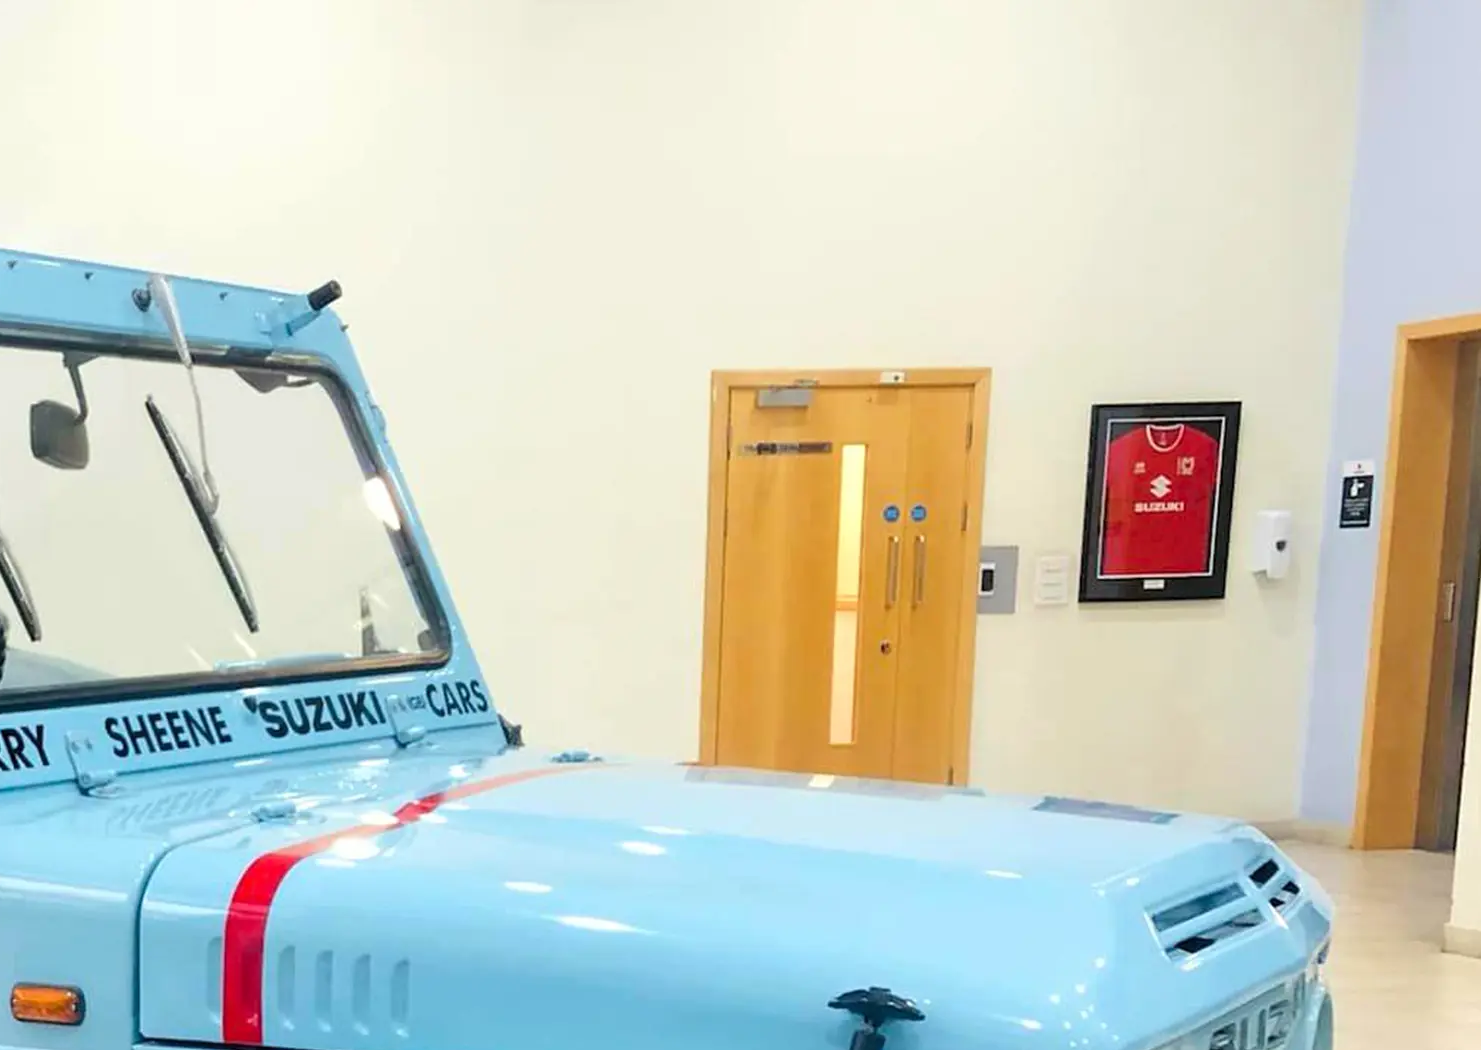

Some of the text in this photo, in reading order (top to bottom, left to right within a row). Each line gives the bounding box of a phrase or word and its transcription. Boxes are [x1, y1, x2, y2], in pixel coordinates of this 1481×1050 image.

[1134, 501, 1185, 513] SUZUKI
[104, 706, 233, 757] SHEENE
[258, 691, 386, 738] SUZUKI
[425, 679, 489, 717] CARS
